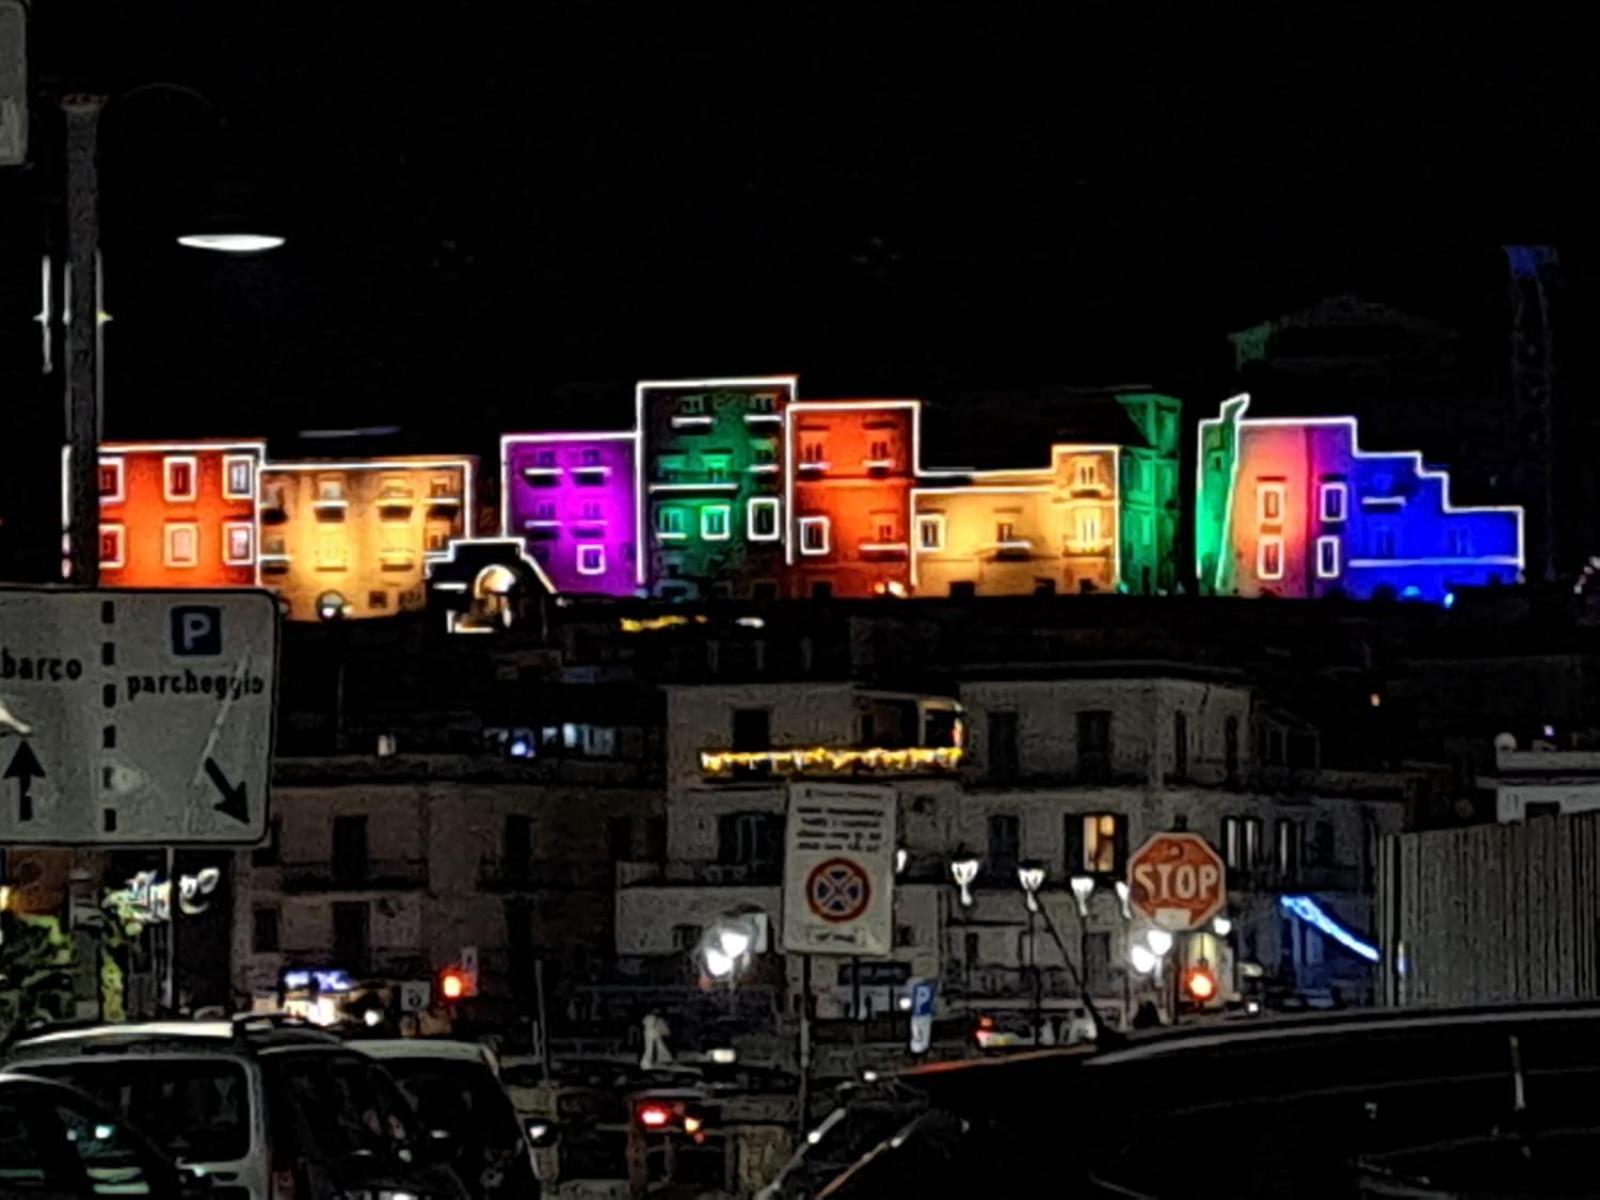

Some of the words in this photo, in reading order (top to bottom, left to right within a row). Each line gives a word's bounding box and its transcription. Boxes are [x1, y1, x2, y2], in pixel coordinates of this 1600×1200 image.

[184, 613, 211, 650] P
[127, 669, 264, 701] parcheggio
[1133, 863, 1218, 901] STOP
